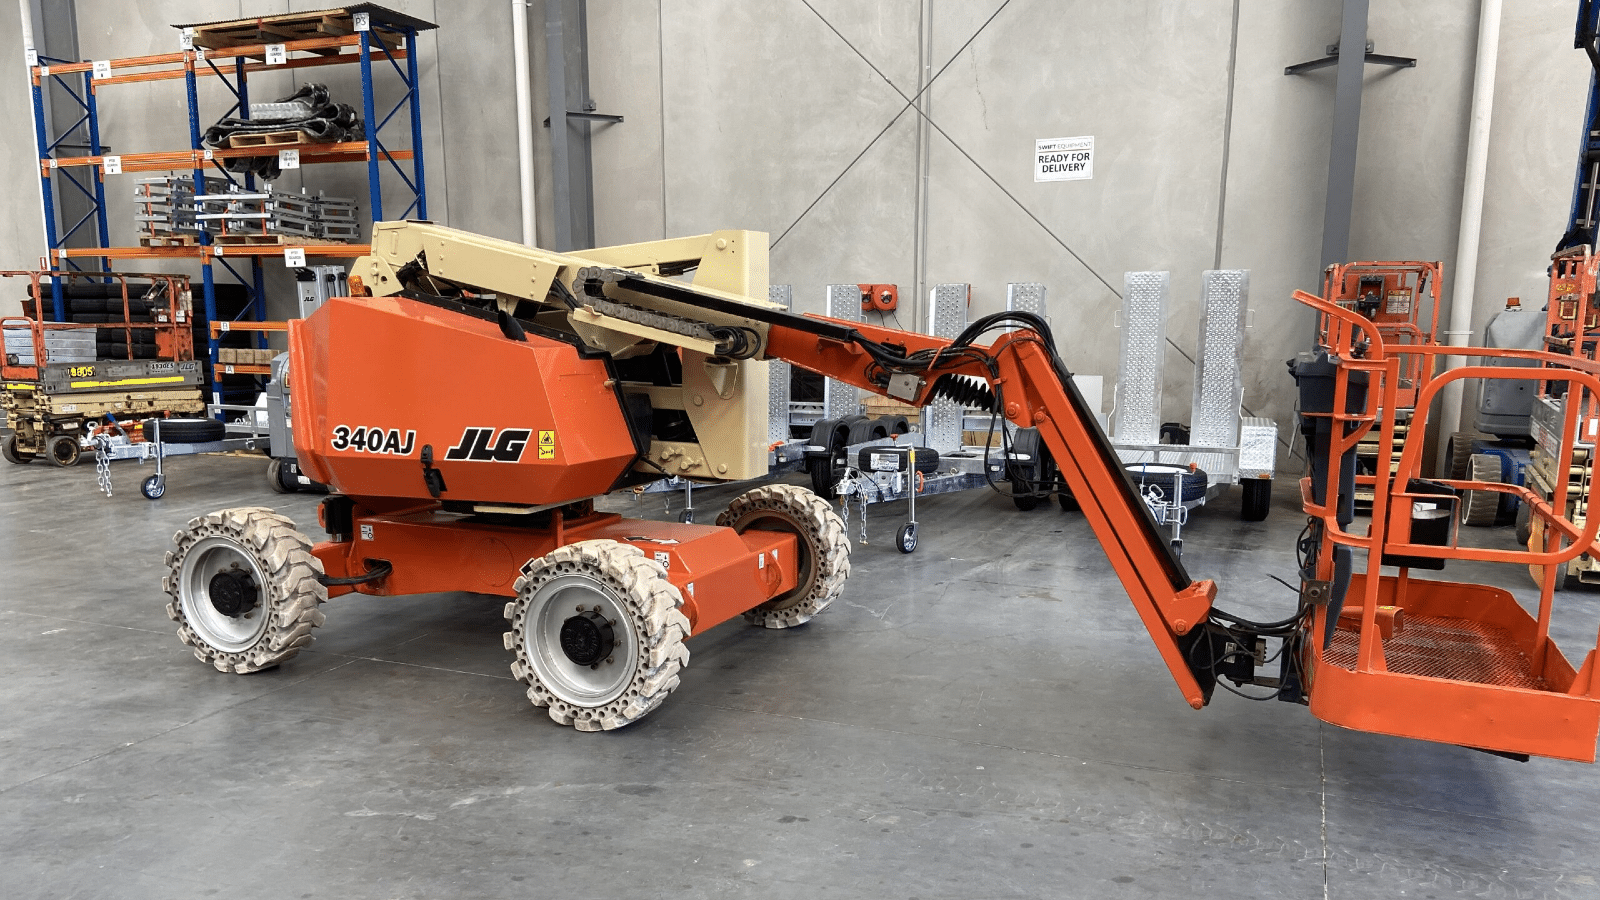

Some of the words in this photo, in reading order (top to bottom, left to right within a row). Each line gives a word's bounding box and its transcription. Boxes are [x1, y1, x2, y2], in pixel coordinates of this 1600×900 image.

[355, 16, 366, 26] P3
[1038, 154, 1069, 163] READY
[1072, 152, 1090, 161] FOR
[1042, 163, 1086, 173] DELIVERY
[332, 425, 416, 456] 340AJ
[445, 427, 532, 462] JLG
